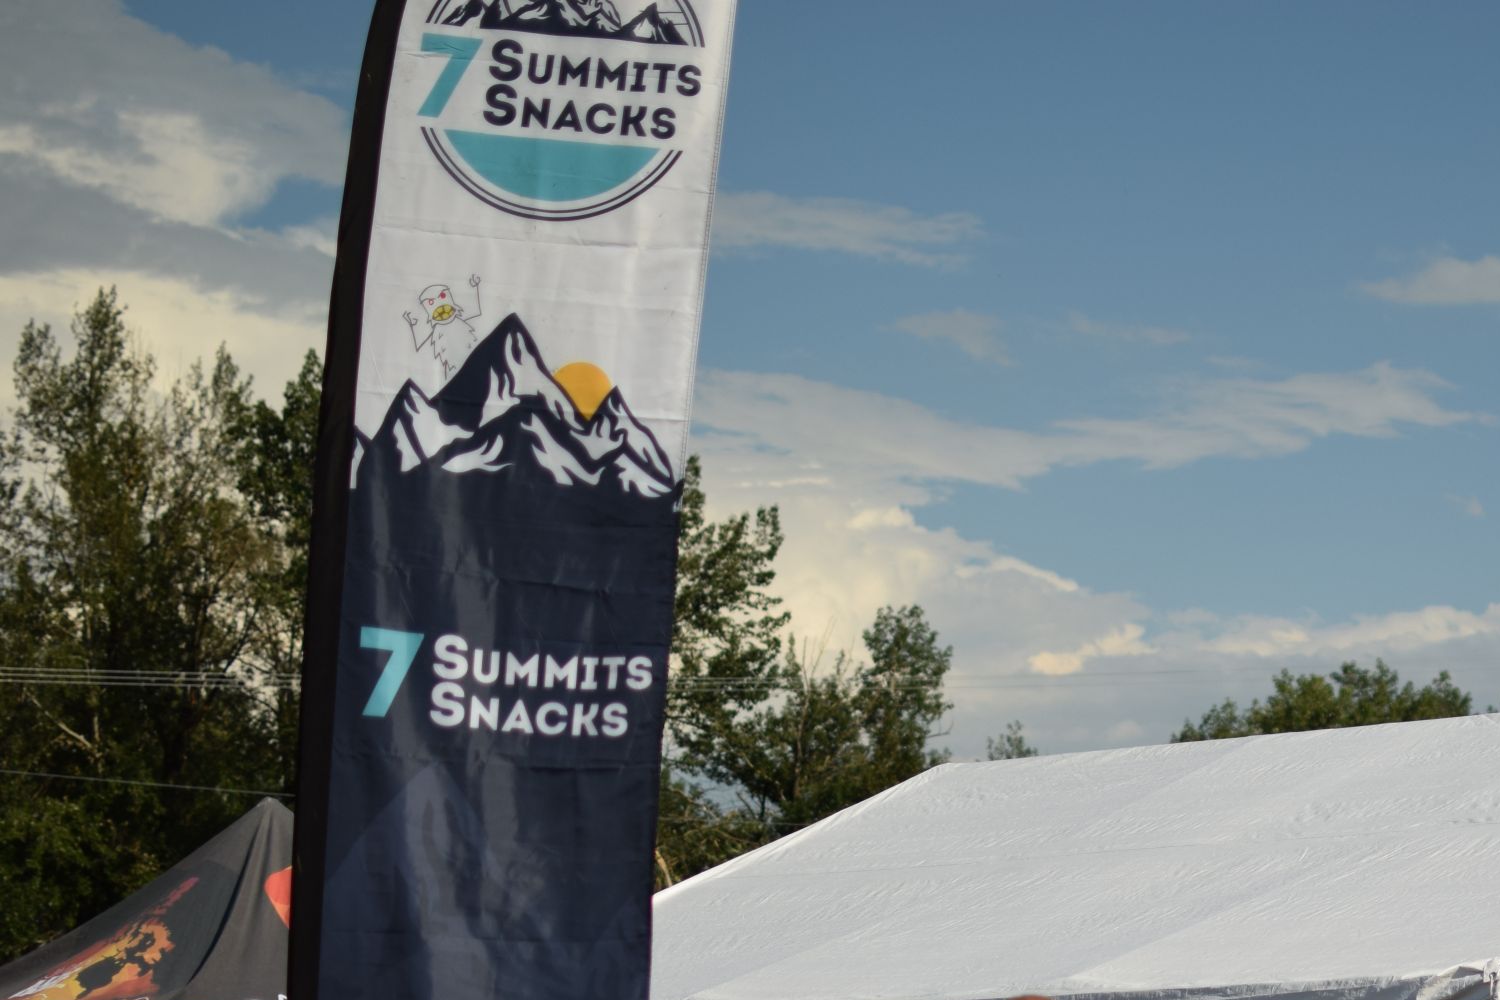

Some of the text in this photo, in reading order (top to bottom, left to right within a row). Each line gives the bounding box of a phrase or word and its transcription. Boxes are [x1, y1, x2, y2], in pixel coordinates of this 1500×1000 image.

[417, 33, 702, 118] 7 SUMMITS
[483, 84, 677, 140] SNACKS
[360, 626, 653, 718] 7 SUMMITS
[430, 682, 628, 737] SNACKS
